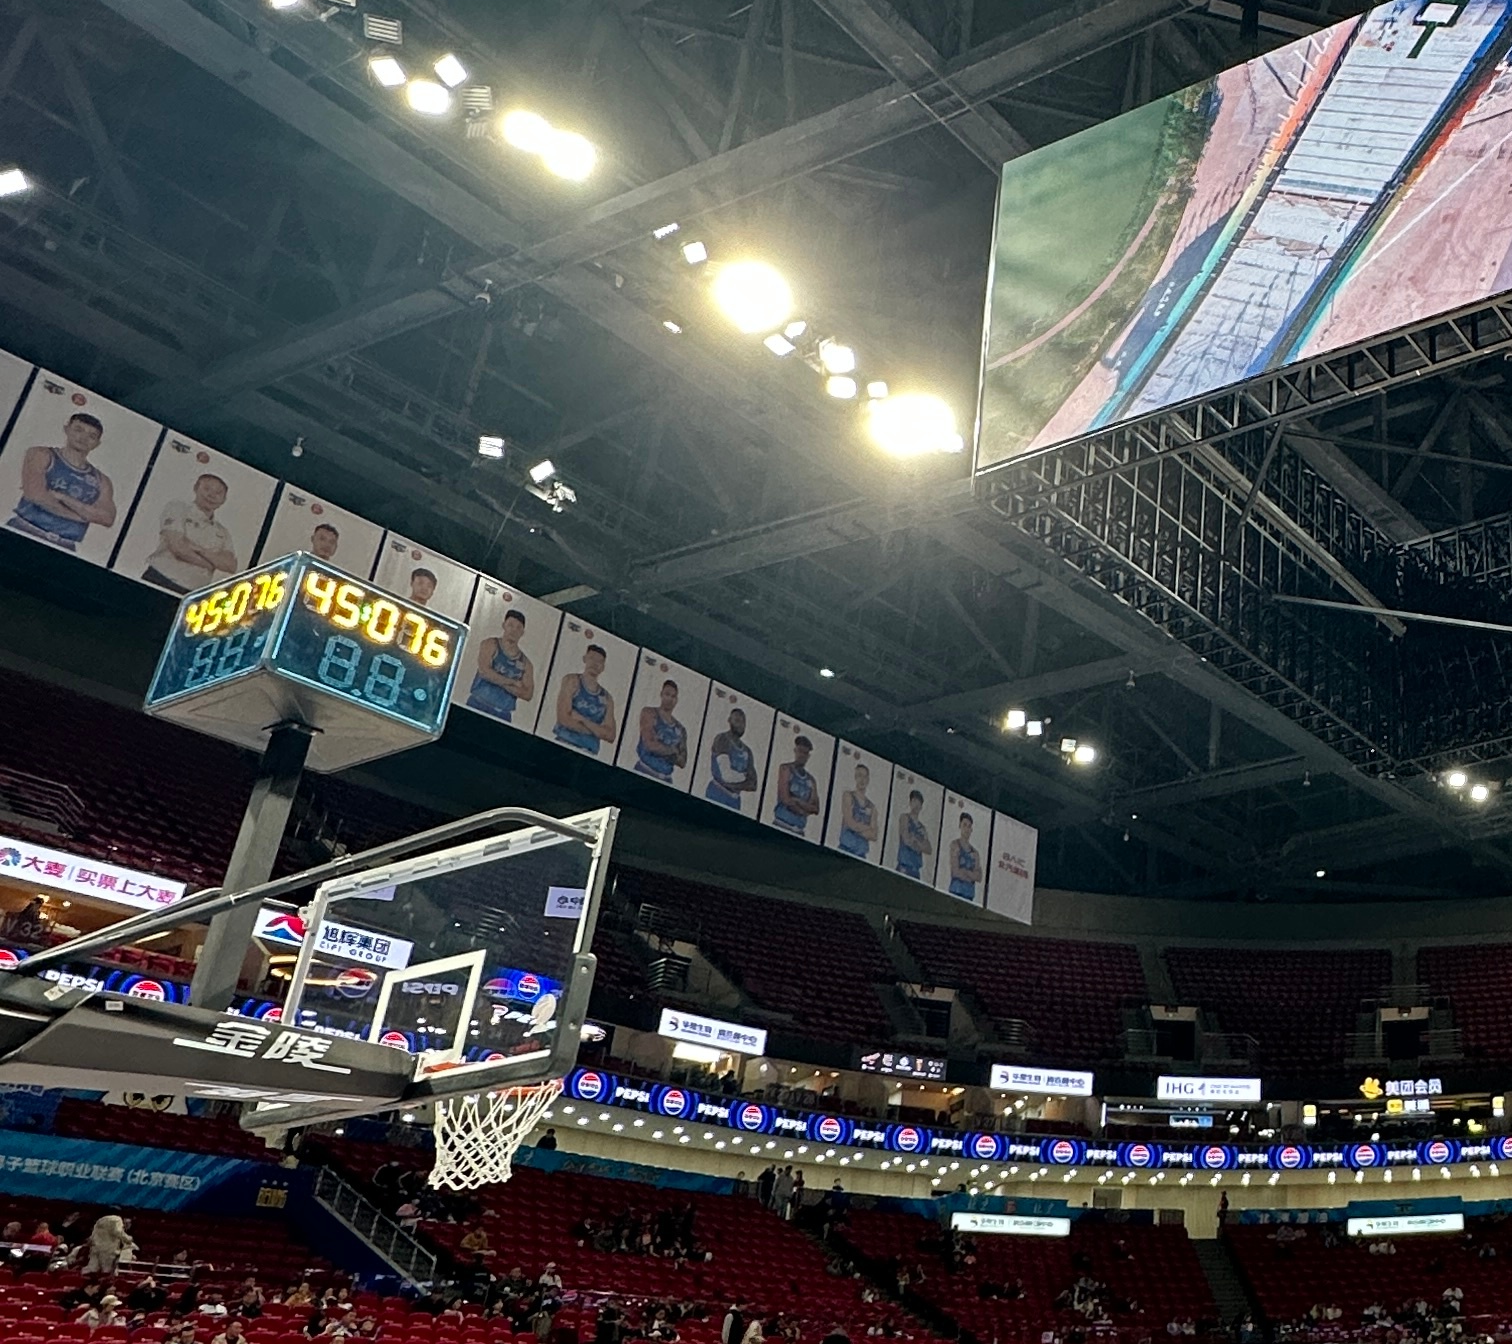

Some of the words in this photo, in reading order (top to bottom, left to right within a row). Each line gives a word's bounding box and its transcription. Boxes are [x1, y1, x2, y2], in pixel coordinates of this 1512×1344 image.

[21, 855, 68, 879] 大麦
[74, 867, 178, 905] 买票上大麦
[322, 925, 391, 956] 旭辉集团
[173, 1020, 352, 1075] 金陵
[1165, 1081, 1195, 1095] IHG
[1385, 1078, 1442, 1096] 美团会员
